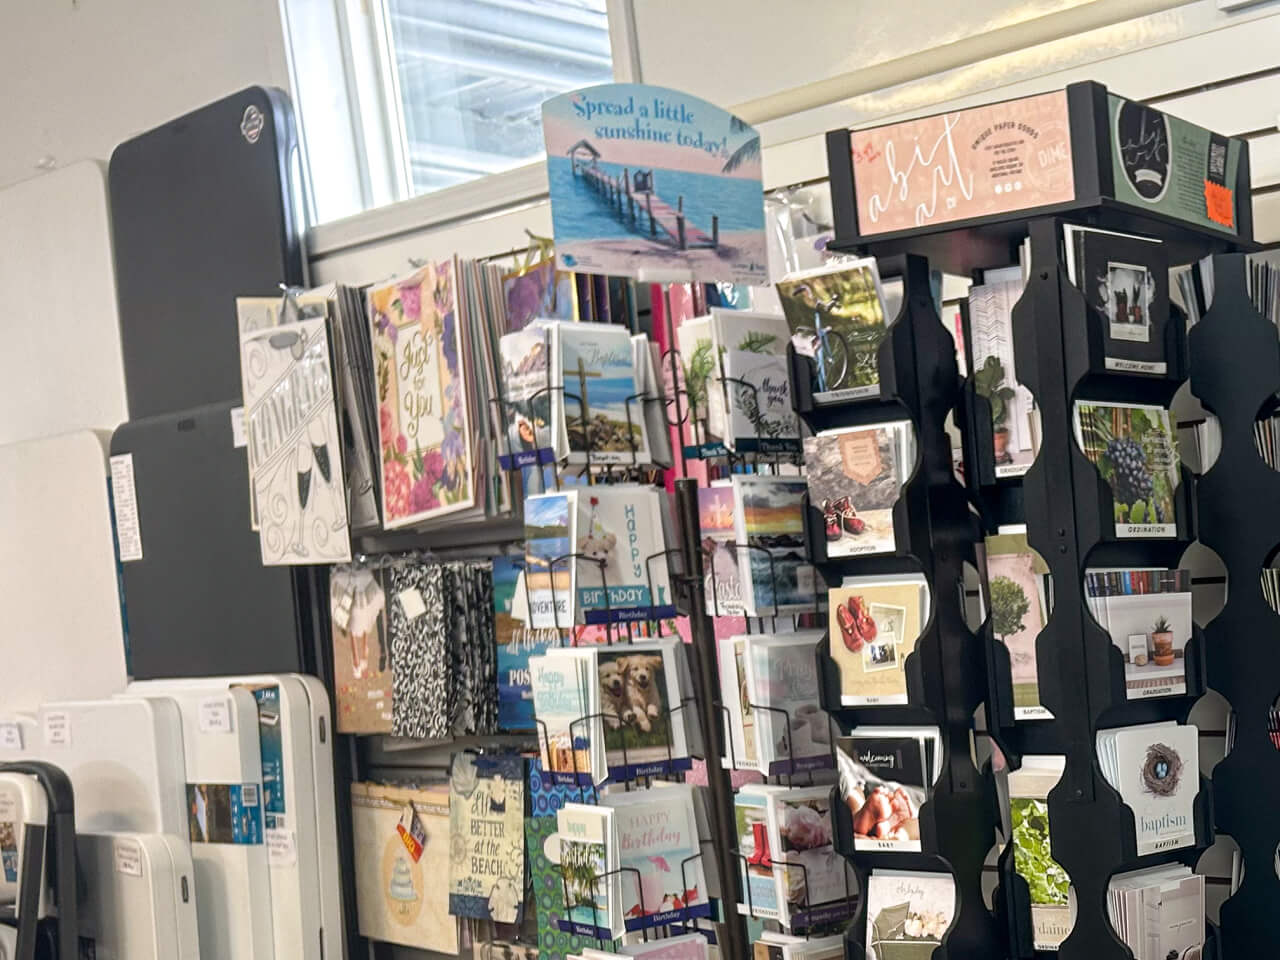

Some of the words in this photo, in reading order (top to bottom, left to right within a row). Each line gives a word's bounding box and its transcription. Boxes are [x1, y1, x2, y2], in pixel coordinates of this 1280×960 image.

[572, 96, 635, 120] Spread
[639, 104, 650, 118] a
[654, 99, 695, 125] little
[993, 121, 1016, 132] PAPER
[594, 118, 673, 143] sunshine
[676, 130, 729, 158] today!
[1039, 142, 1068, 169] DIME
[400, 328, 435, 381] Just
[403, 393, 435, 440] You
[470, 819, 505, 838] BETTER
[629, 809, 671, 829] HAPPY
[1138, 811, 1188, 834] baptism
[474, 840, 484, 854] at
[486, 838, 502, 855] the
[621, 828, 682, 851] Birthday
[876, 840, 895, 849] BABY
[1154, 837, 1181, 850] BAPTISM
[471, 858, 504, 876] BEACH
[653, 911, 681, 923] Birthday
